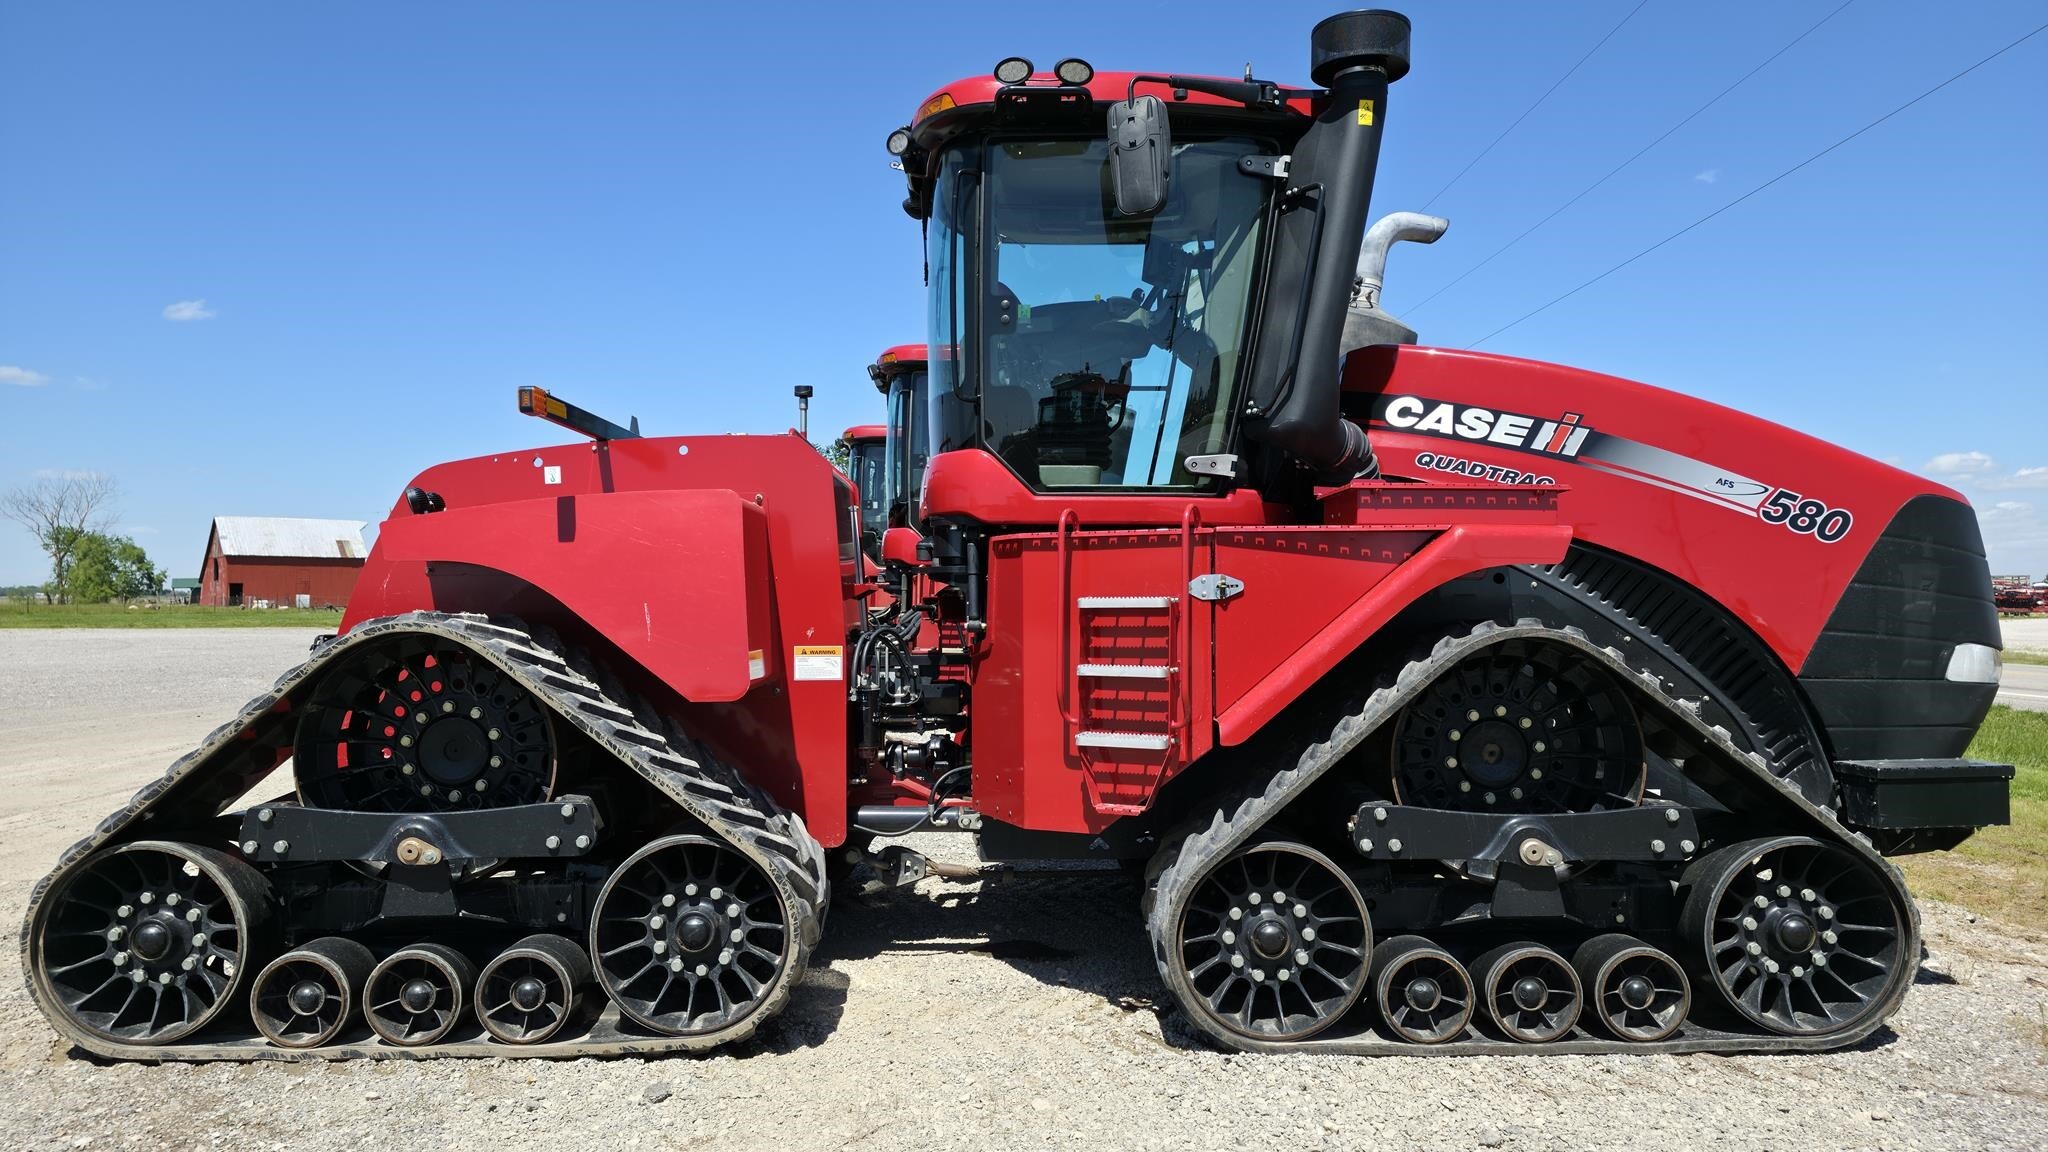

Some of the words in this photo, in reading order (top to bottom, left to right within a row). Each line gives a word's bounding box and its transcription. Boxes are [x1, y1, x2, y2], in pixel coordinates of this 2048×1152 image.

[1385, 396, 1534, 446] CASE
[1716, 477, 1735, 489] AFS
[1760, 488, 1853, 543] 580
